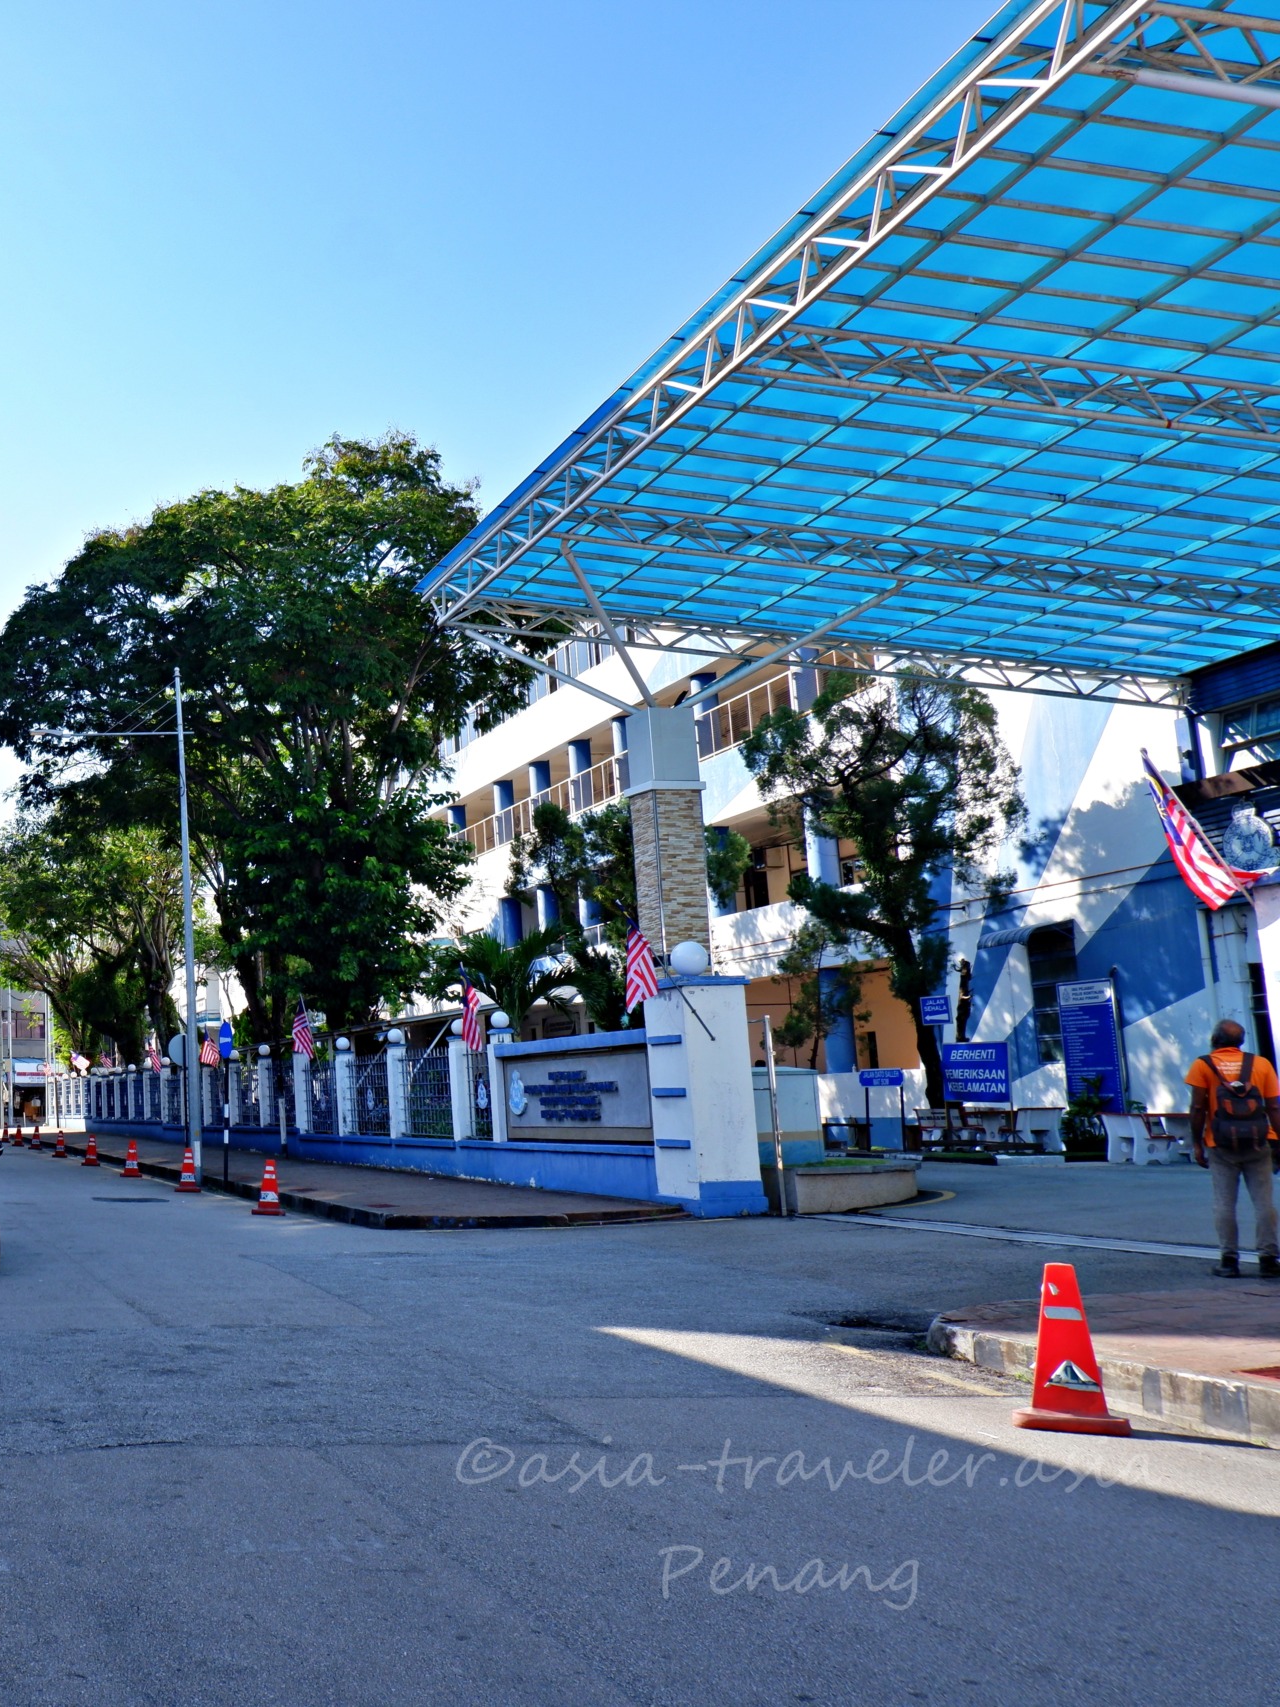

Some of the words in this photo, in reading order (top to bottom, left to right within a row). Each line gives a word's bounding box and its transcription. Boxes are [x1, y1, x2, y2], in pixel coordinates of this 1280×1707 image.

[950, 1049, 996, 1060] BERHENTI
[945, 1069, 1006, 1080] PEMERIKSAAN
[948, 1082, 1006, 1093] KESELAMATAN
